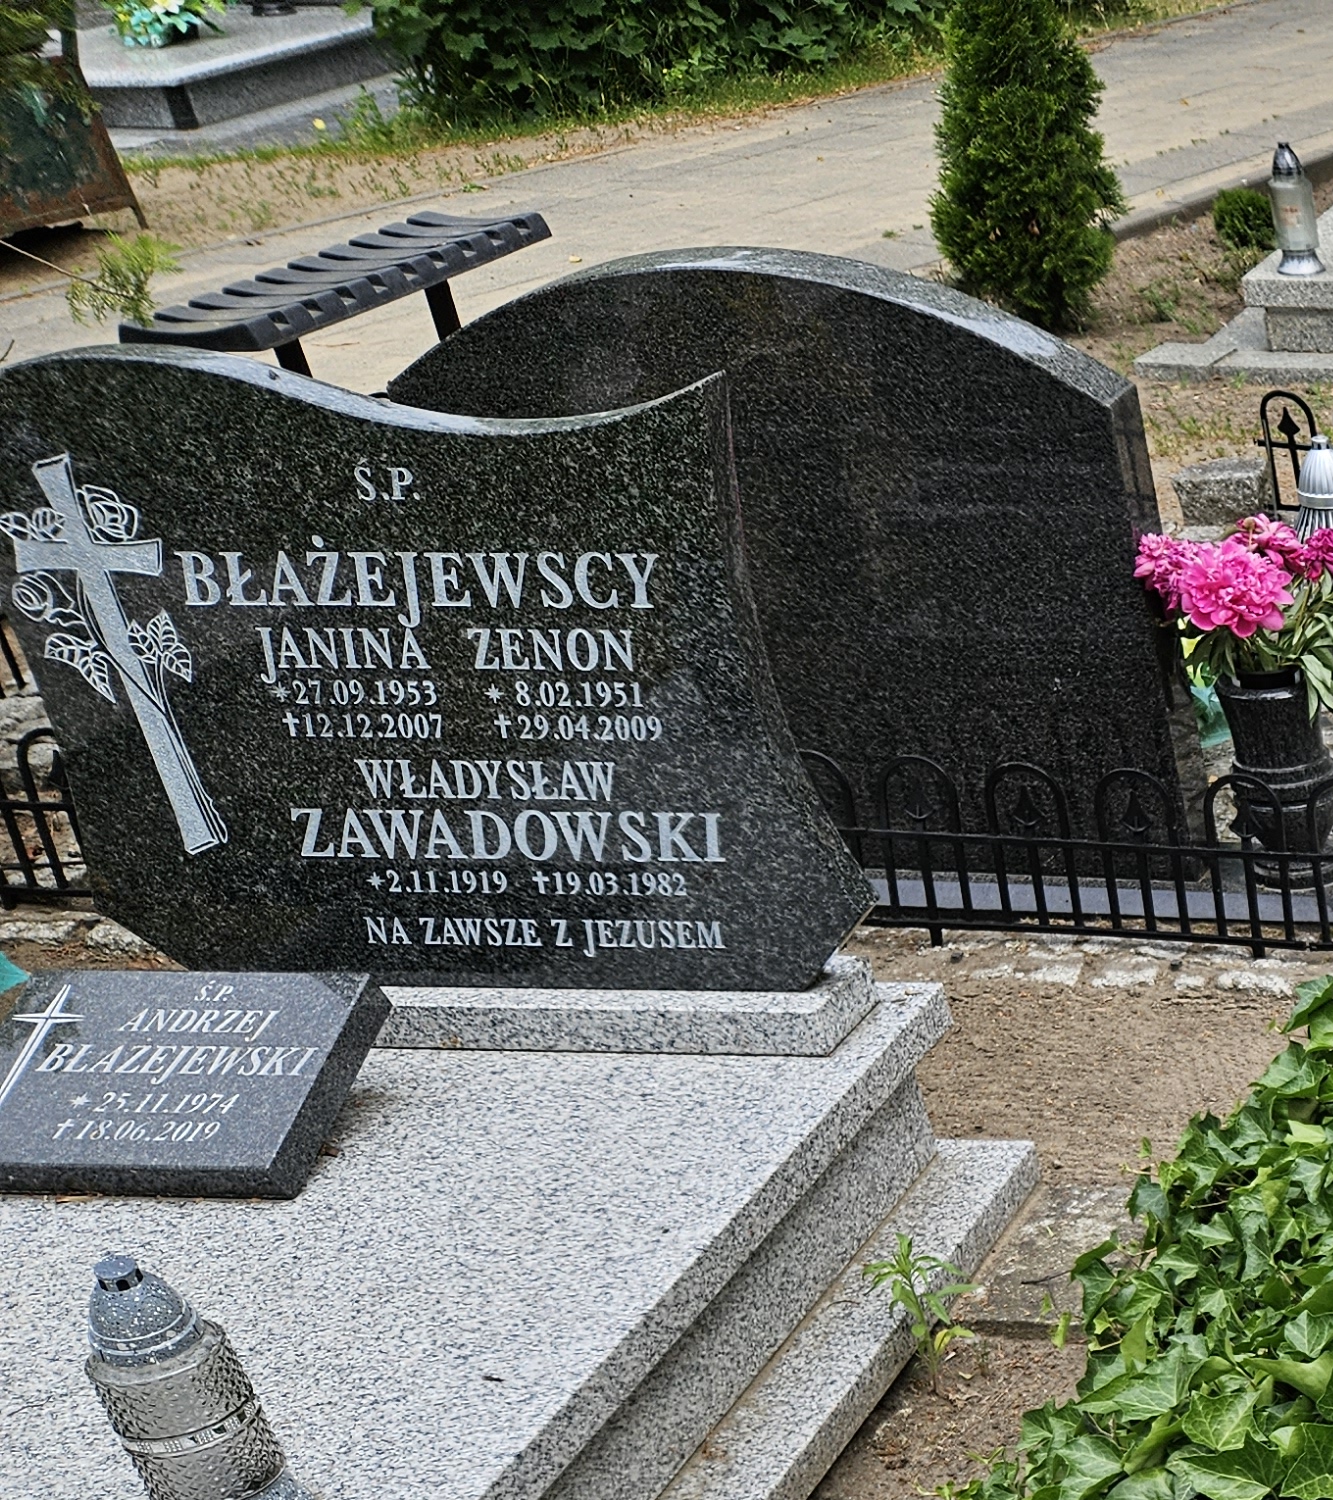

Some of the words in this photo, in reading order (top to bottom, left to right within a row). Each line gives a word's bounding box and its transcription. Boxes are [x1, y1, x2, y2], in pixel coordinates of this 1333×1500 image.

[355, 458, 421, 501] Ś.P.
[174, 535, 659, 625] BŁAŻEJEWSCY
[257, 626, 431, 685] JANINA
[468, 628, 635, 672] ZENON
[357, 759, 616, 801] WŁADYSŁAW
[290, 809, 726, 863] ZAWADOWSKI
[366, 917, 412, 946] NA
[420, 917, 543, 947] ZAWSZE
[551, 919, 575, 947] Z
[583, 919, 726, 957] JEZUSEM
[118, 1008, 281, 1042] ANDRZEJ
